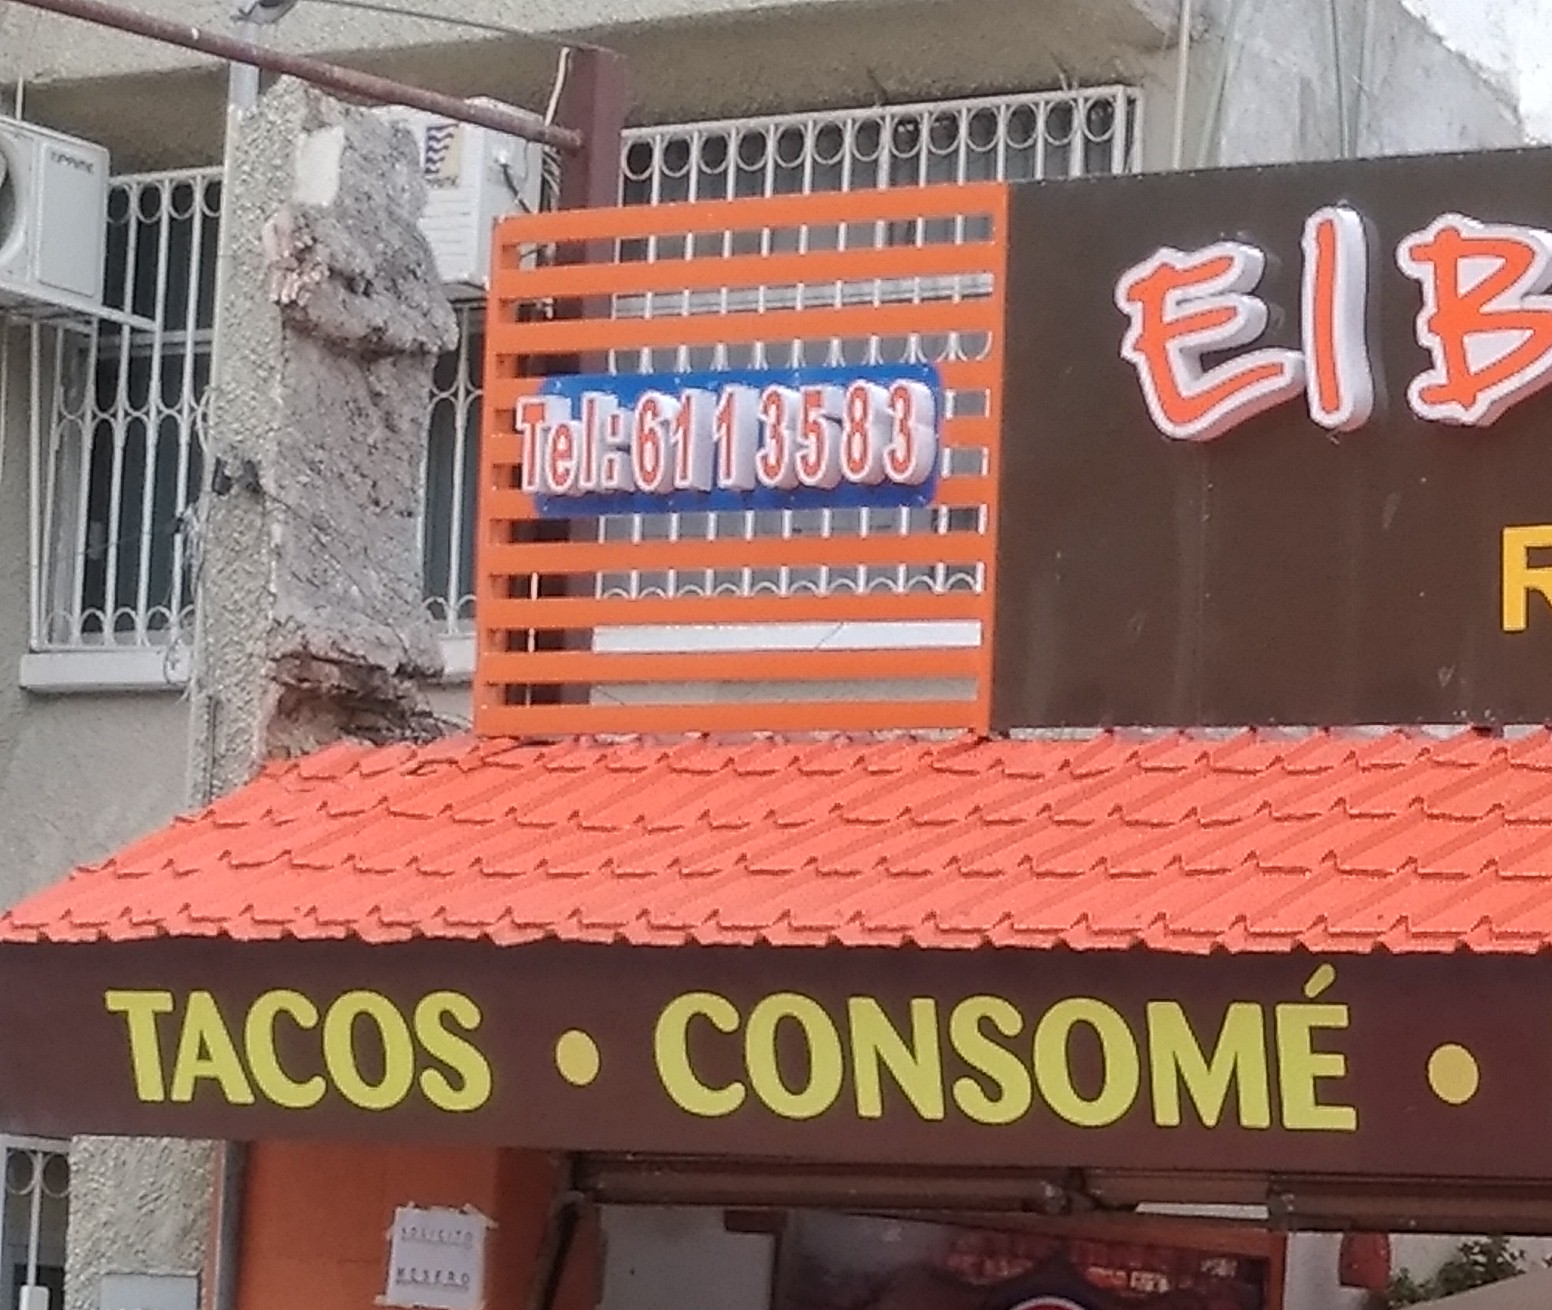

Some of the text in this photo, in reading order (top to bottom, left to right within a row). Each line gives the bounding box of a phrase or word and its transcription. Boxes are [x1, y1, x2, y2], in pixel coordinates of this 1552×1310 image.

[1117, 207, 1368, 440] El
[105, 989, 494, 1112] TACOS
[654, 964, 1358, 1132] CONSOMÉ
